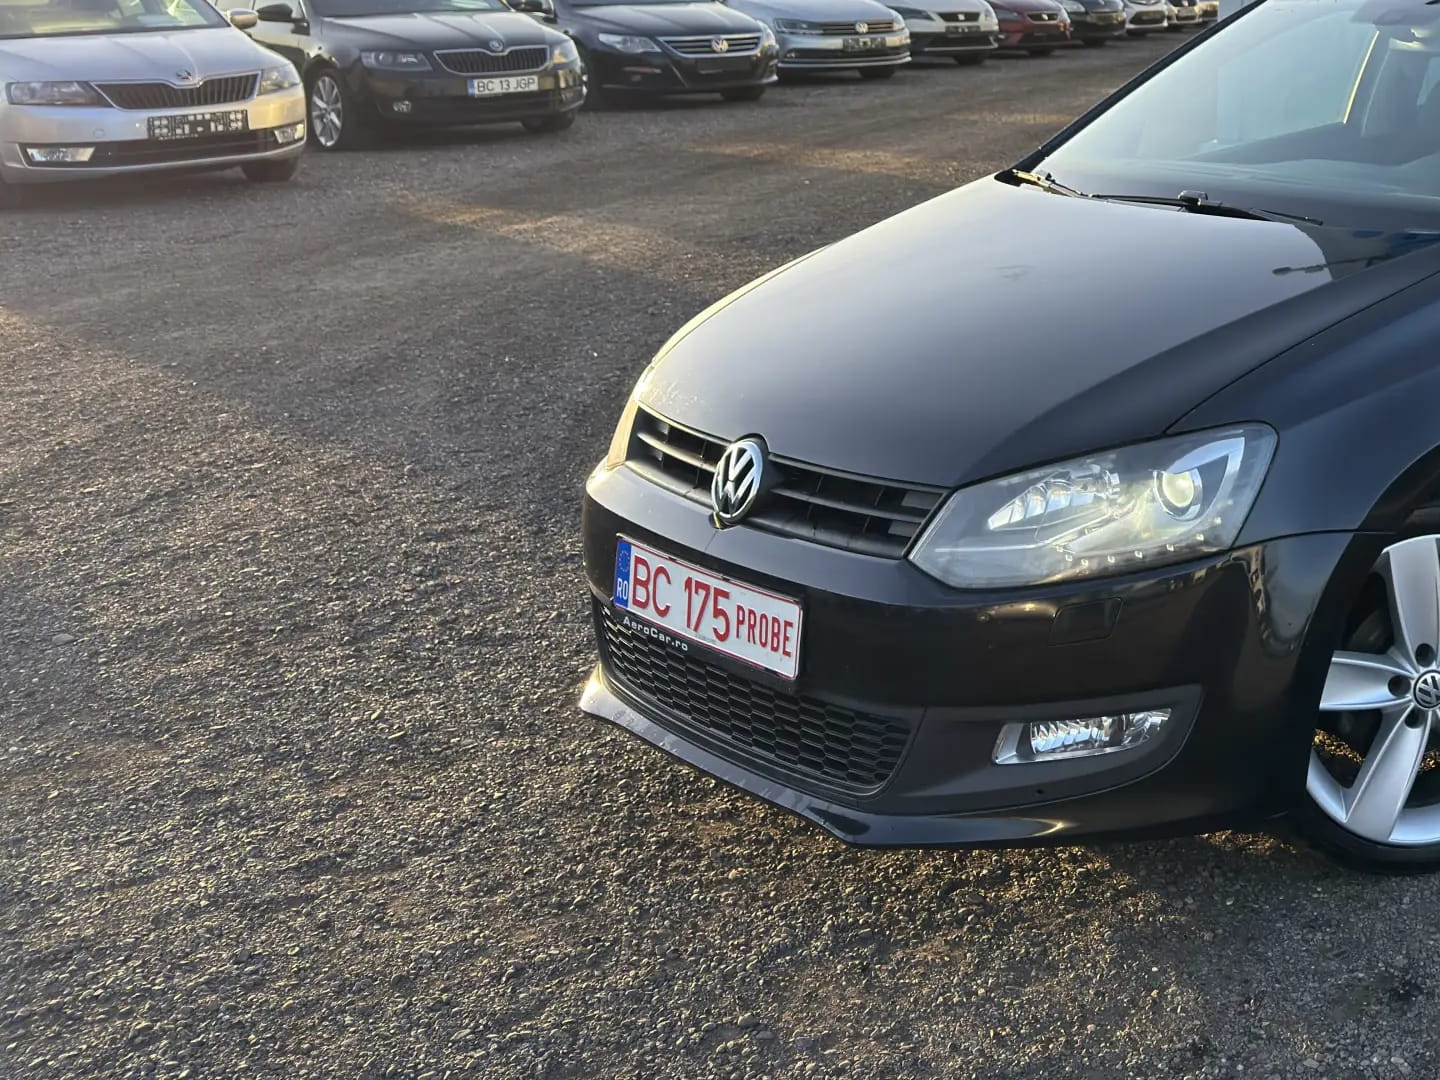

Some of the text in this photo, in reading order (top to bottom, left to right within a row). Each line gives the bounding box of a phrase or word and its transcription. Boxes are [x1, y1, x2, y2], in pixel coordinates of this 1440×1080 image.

[476, 77, 536, 93] BC 13 JGP
[616, 577, 629, 601] RO
[631, 554, 794, 658] BC 175 PROBE
[622, 615, 689, 652] AeroCar.ro
